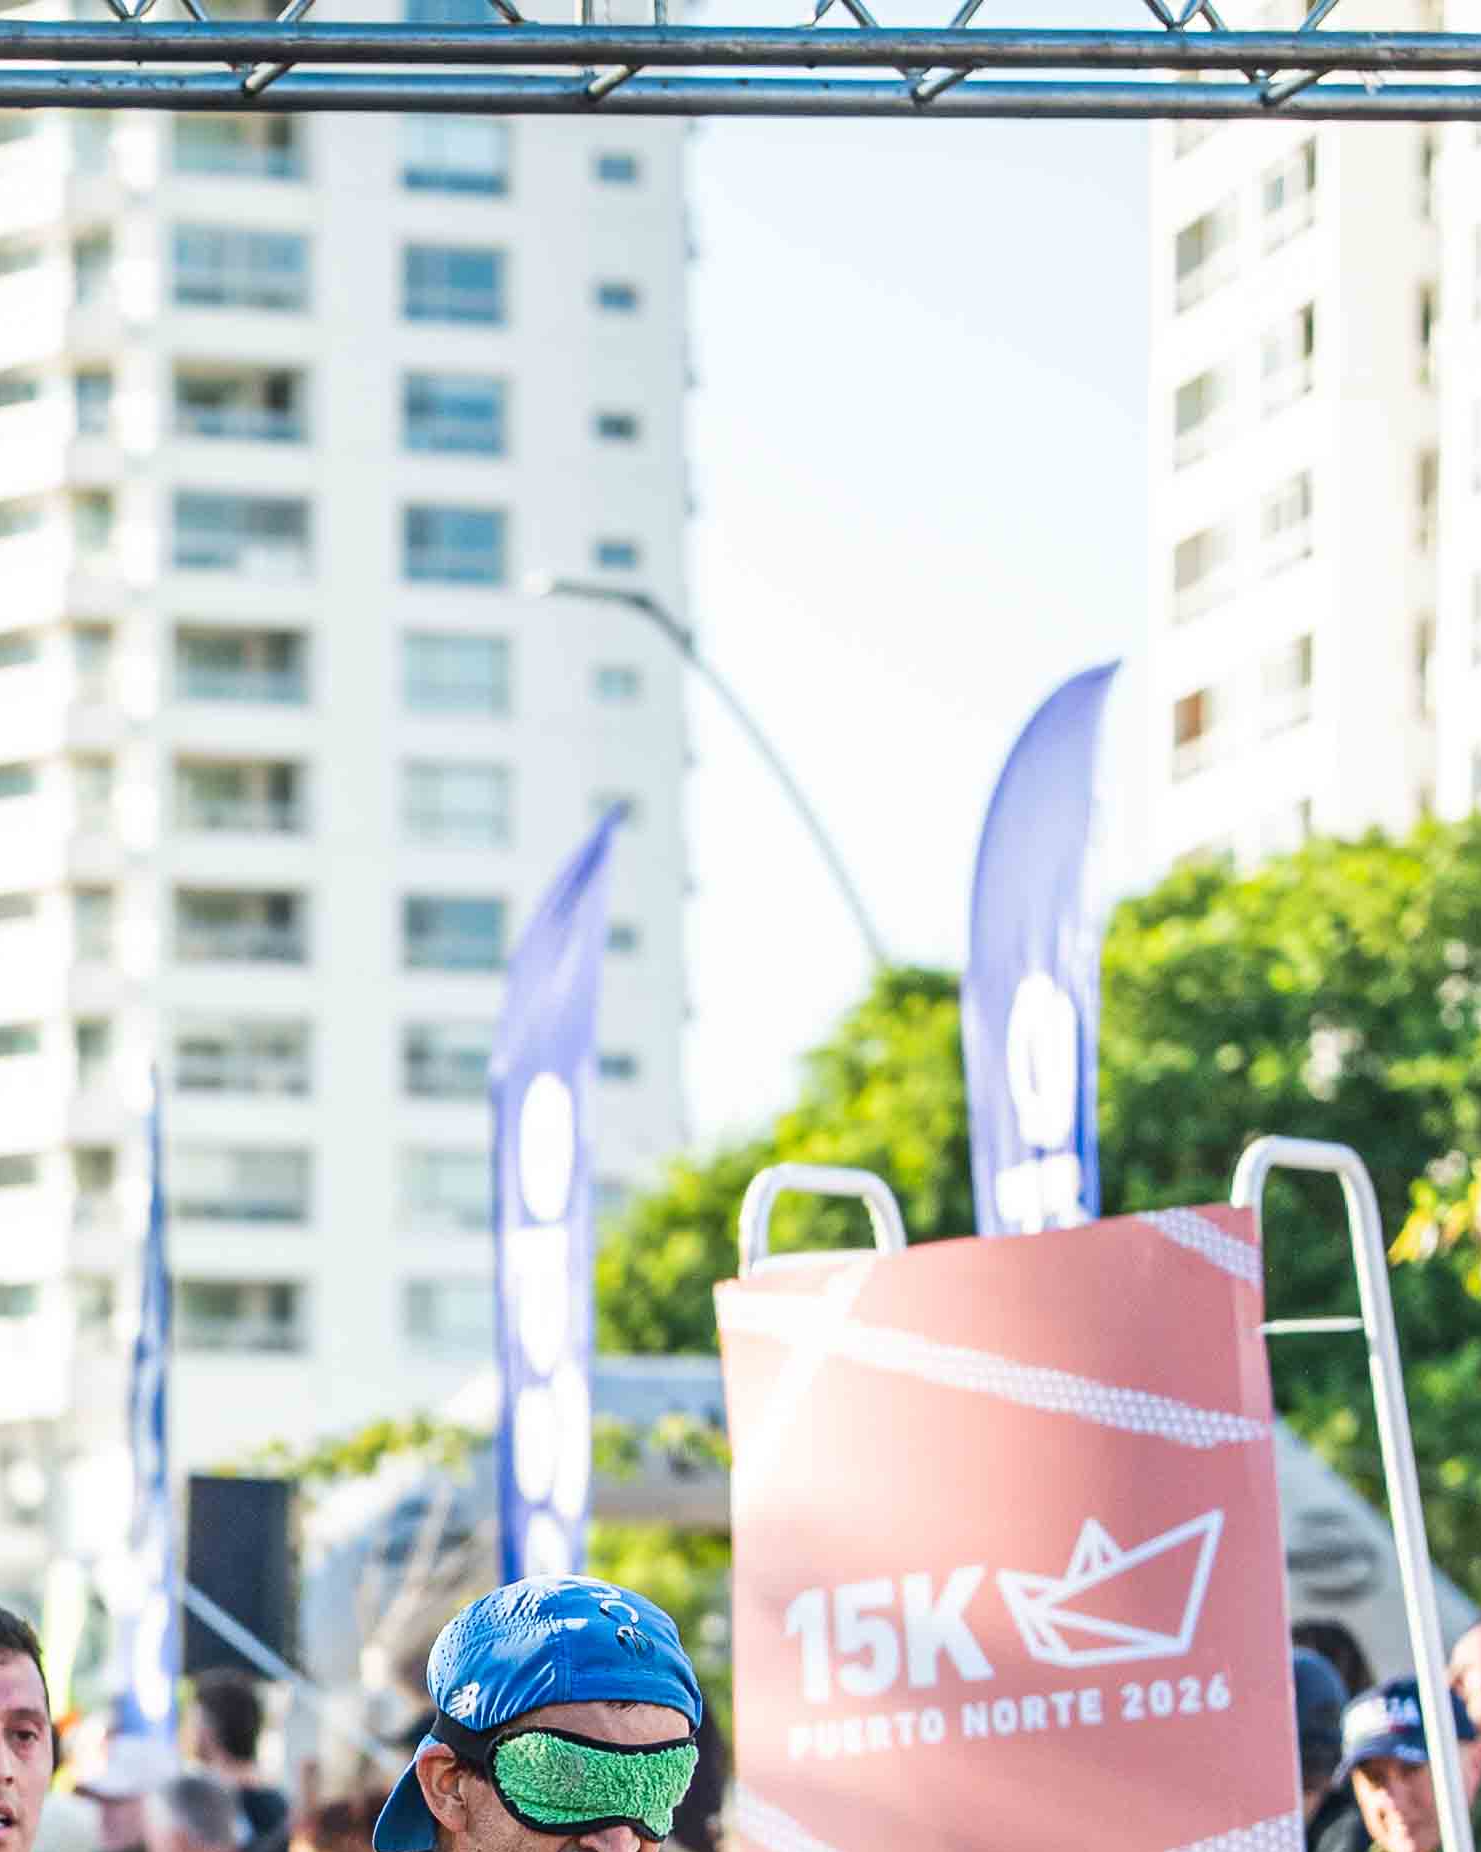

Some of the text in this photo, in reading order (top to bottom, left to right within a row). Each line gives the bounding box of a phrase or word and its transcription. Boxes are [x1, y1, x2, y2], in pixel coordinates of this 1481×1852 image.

[783, 1563, 995, 1704] 15K
[788, 1674, 1232, 1761] PUERTO NORTE 2026
